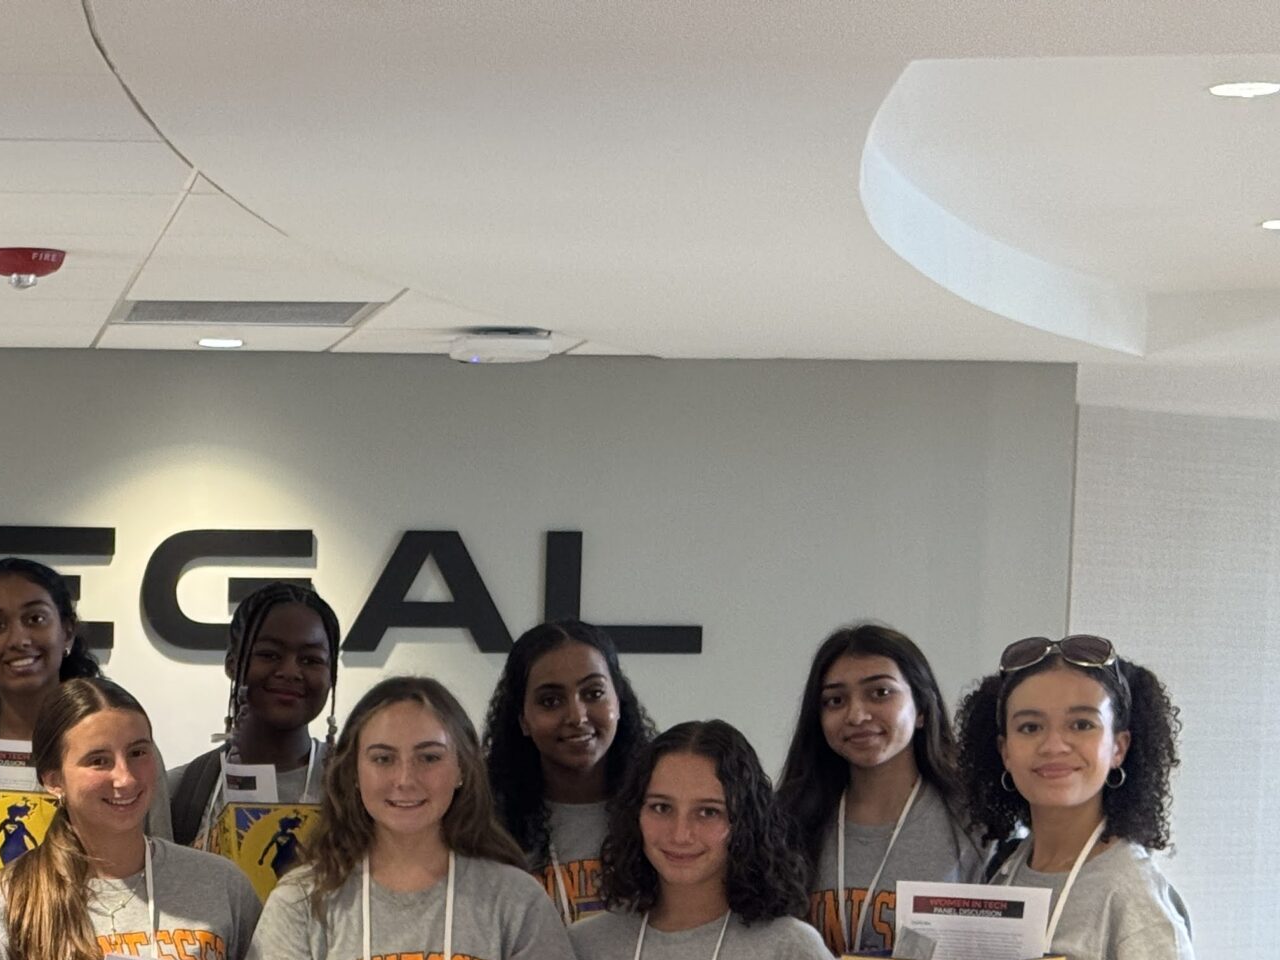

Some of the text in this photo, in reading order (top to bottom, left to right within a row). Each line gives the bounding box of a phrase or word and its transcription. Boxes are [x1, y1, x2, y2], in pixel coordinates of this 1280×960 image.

[31, 252, 58, 262] FIRE
[930, 899, 1007, 910] WOMEN IN TECH
[933, 907, 1002, 917] PANEL DISCUSSION
